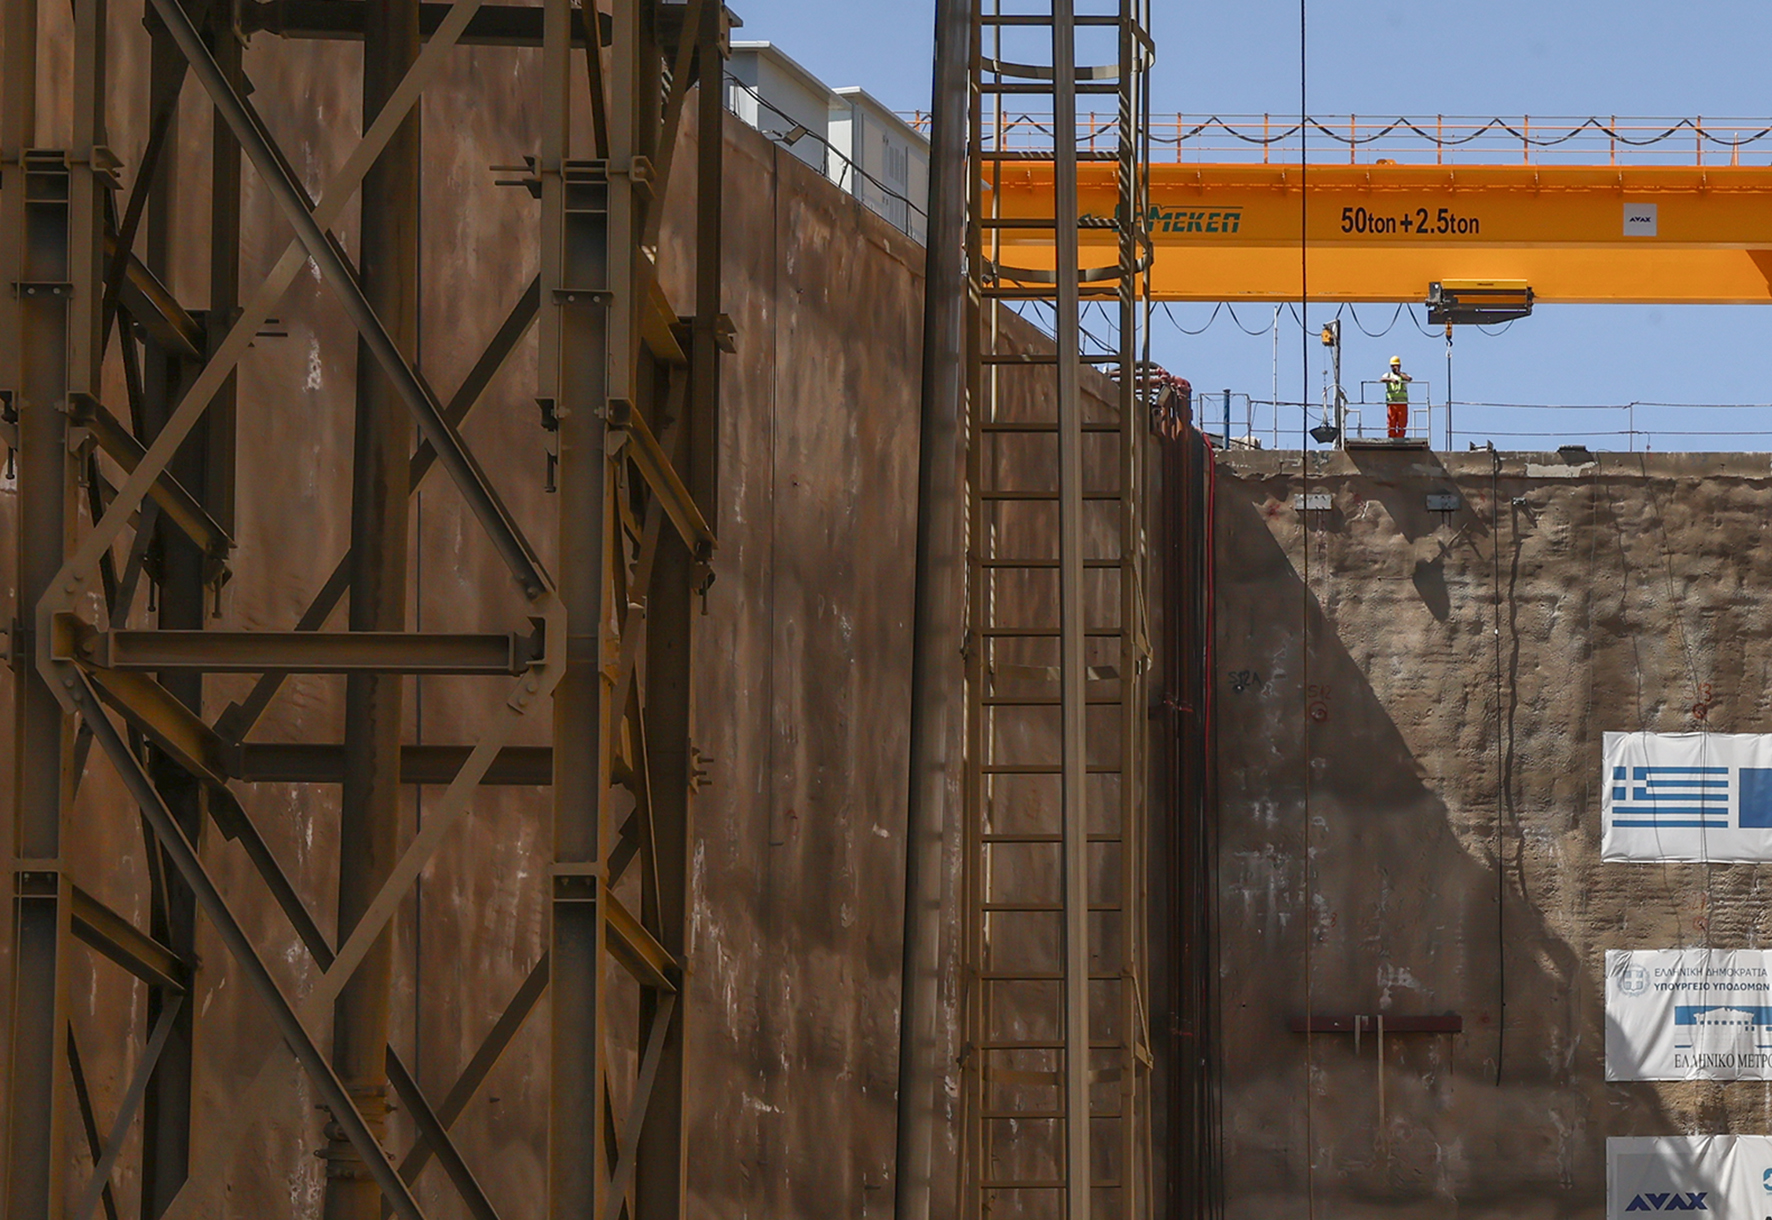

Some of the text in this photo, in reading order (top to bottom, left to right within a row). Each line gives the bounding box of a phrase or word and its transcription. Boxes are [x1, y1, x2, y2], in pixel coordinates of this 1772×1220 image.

[1308, 685, 1331, 700] S12
[1654, 967, 1768, 977] ΕΛΛΗΝΙΚΗ ΔΗΜΟΚΡΑΤΙΑ
[1654, 982, 1710, 992] ΥΠΟΥΡΓΕΙΟ
[1713, 982, 1770, 992] ΥΠΟΔΟΜΩΝ
[1674, 1053, 1735, 1069] ΕΛΛΗΝΙΚΟ
[1625, 1192, 1708, 1211] AVAX
